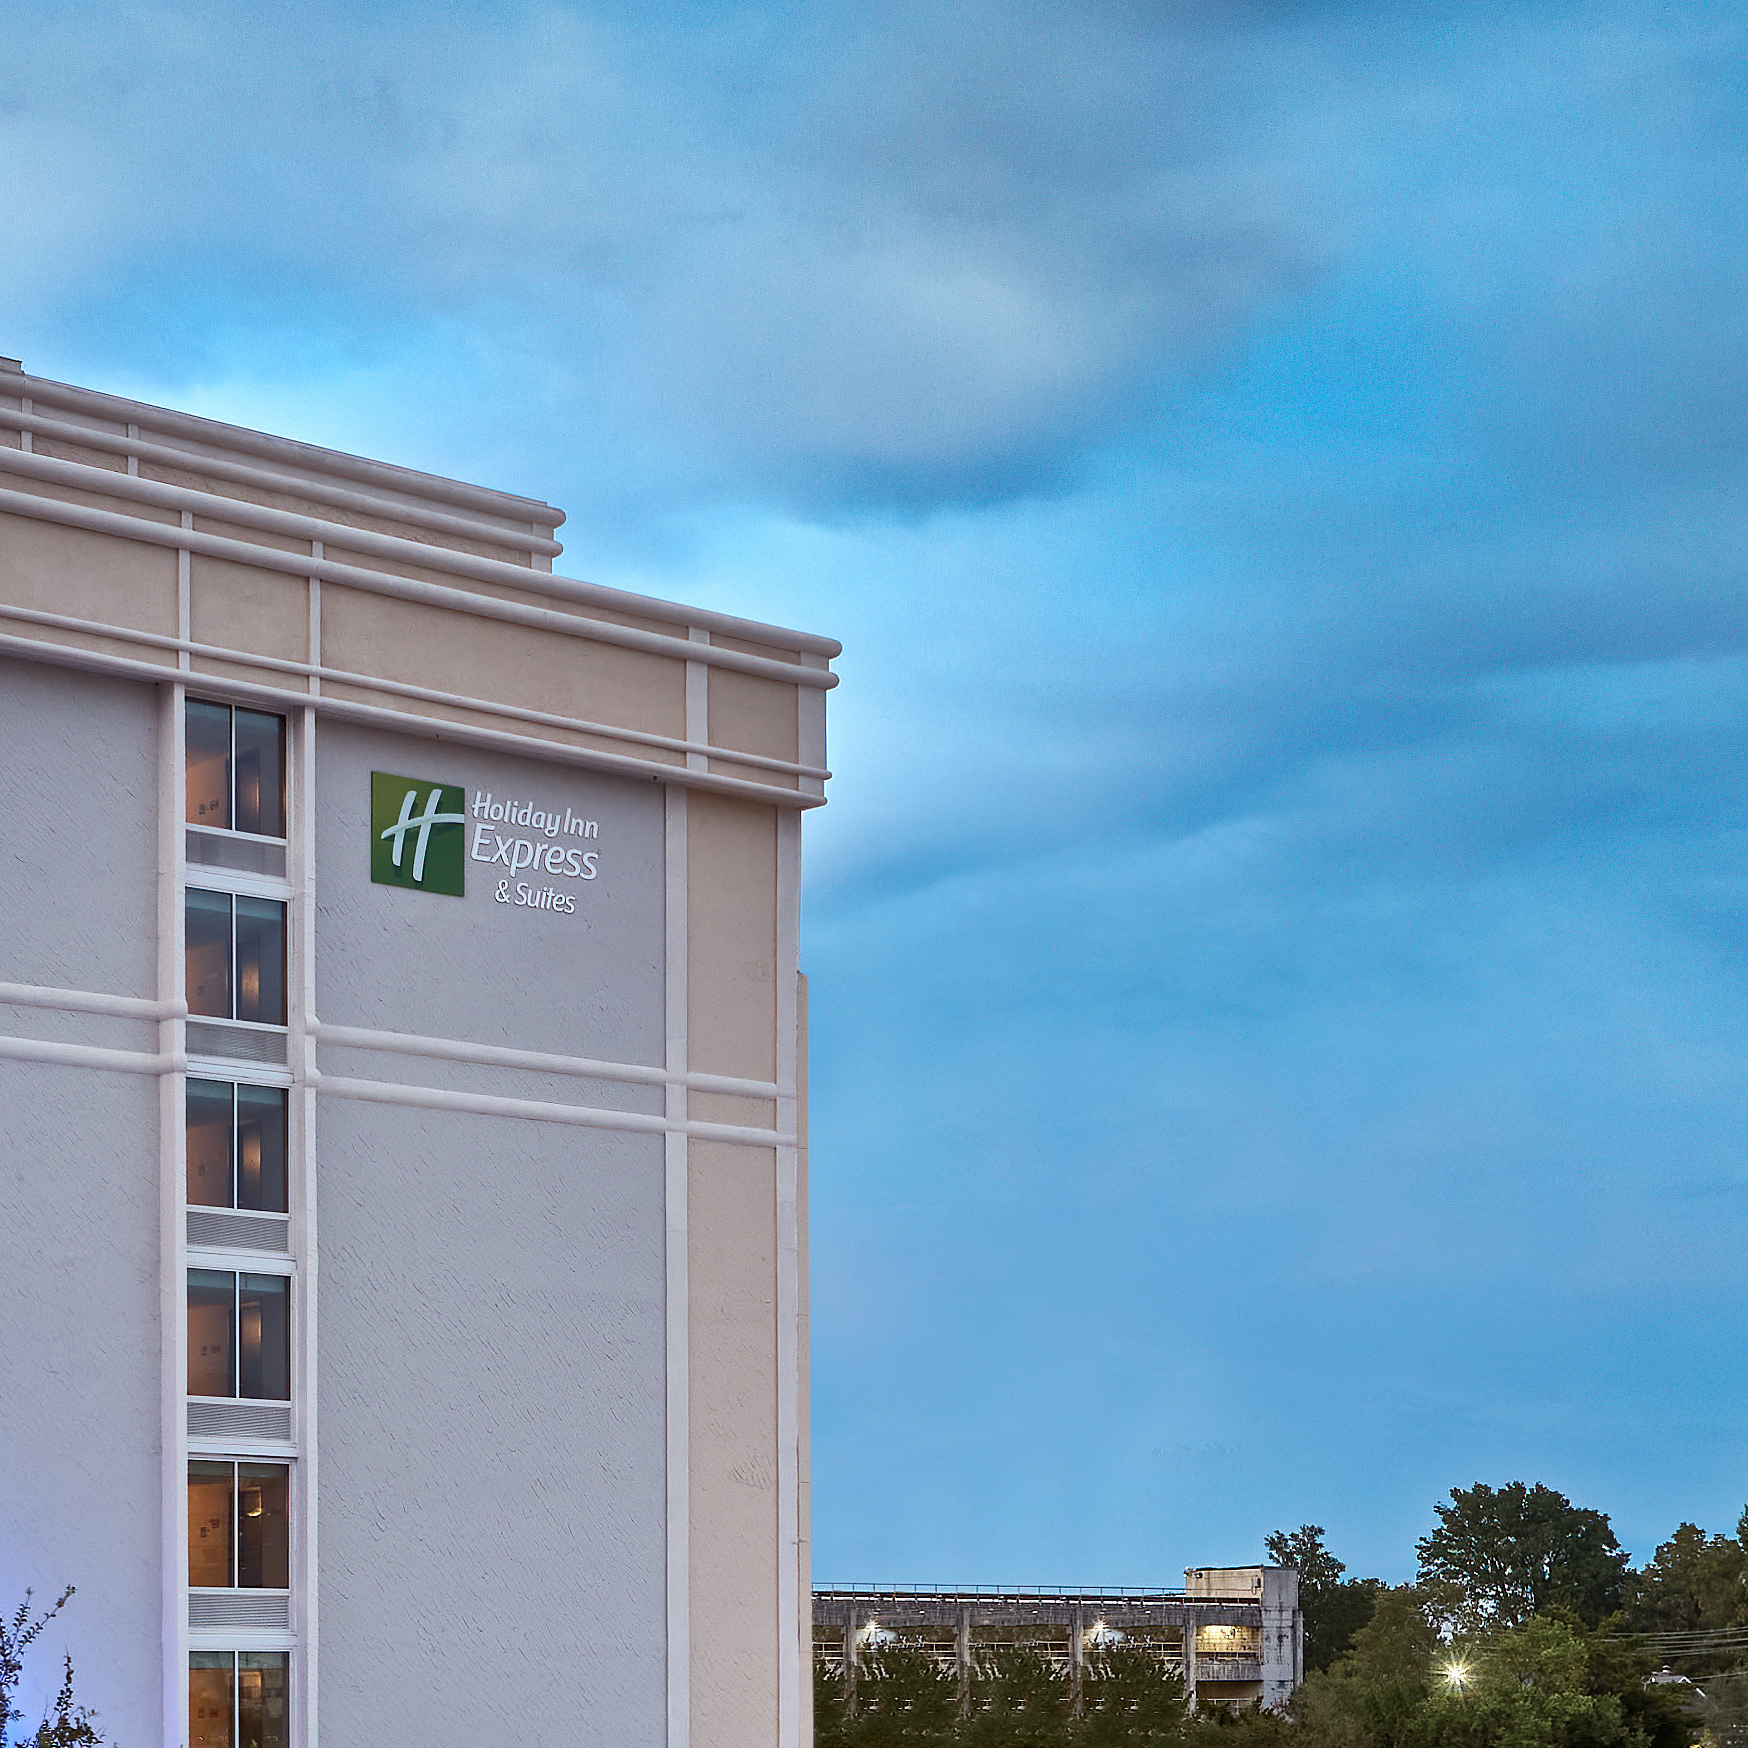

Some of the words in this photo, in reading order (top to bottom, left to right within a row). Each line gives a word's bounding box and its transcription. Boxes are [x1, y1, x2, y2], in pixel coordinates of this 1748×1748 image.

[472, 791, 561, 838] Holiday
[563, 807, 599, 839] Inn
[471, 822, 599, 880] Express
[494, 879, 510, 904] &
[514, 882, 576, 914] Suites
